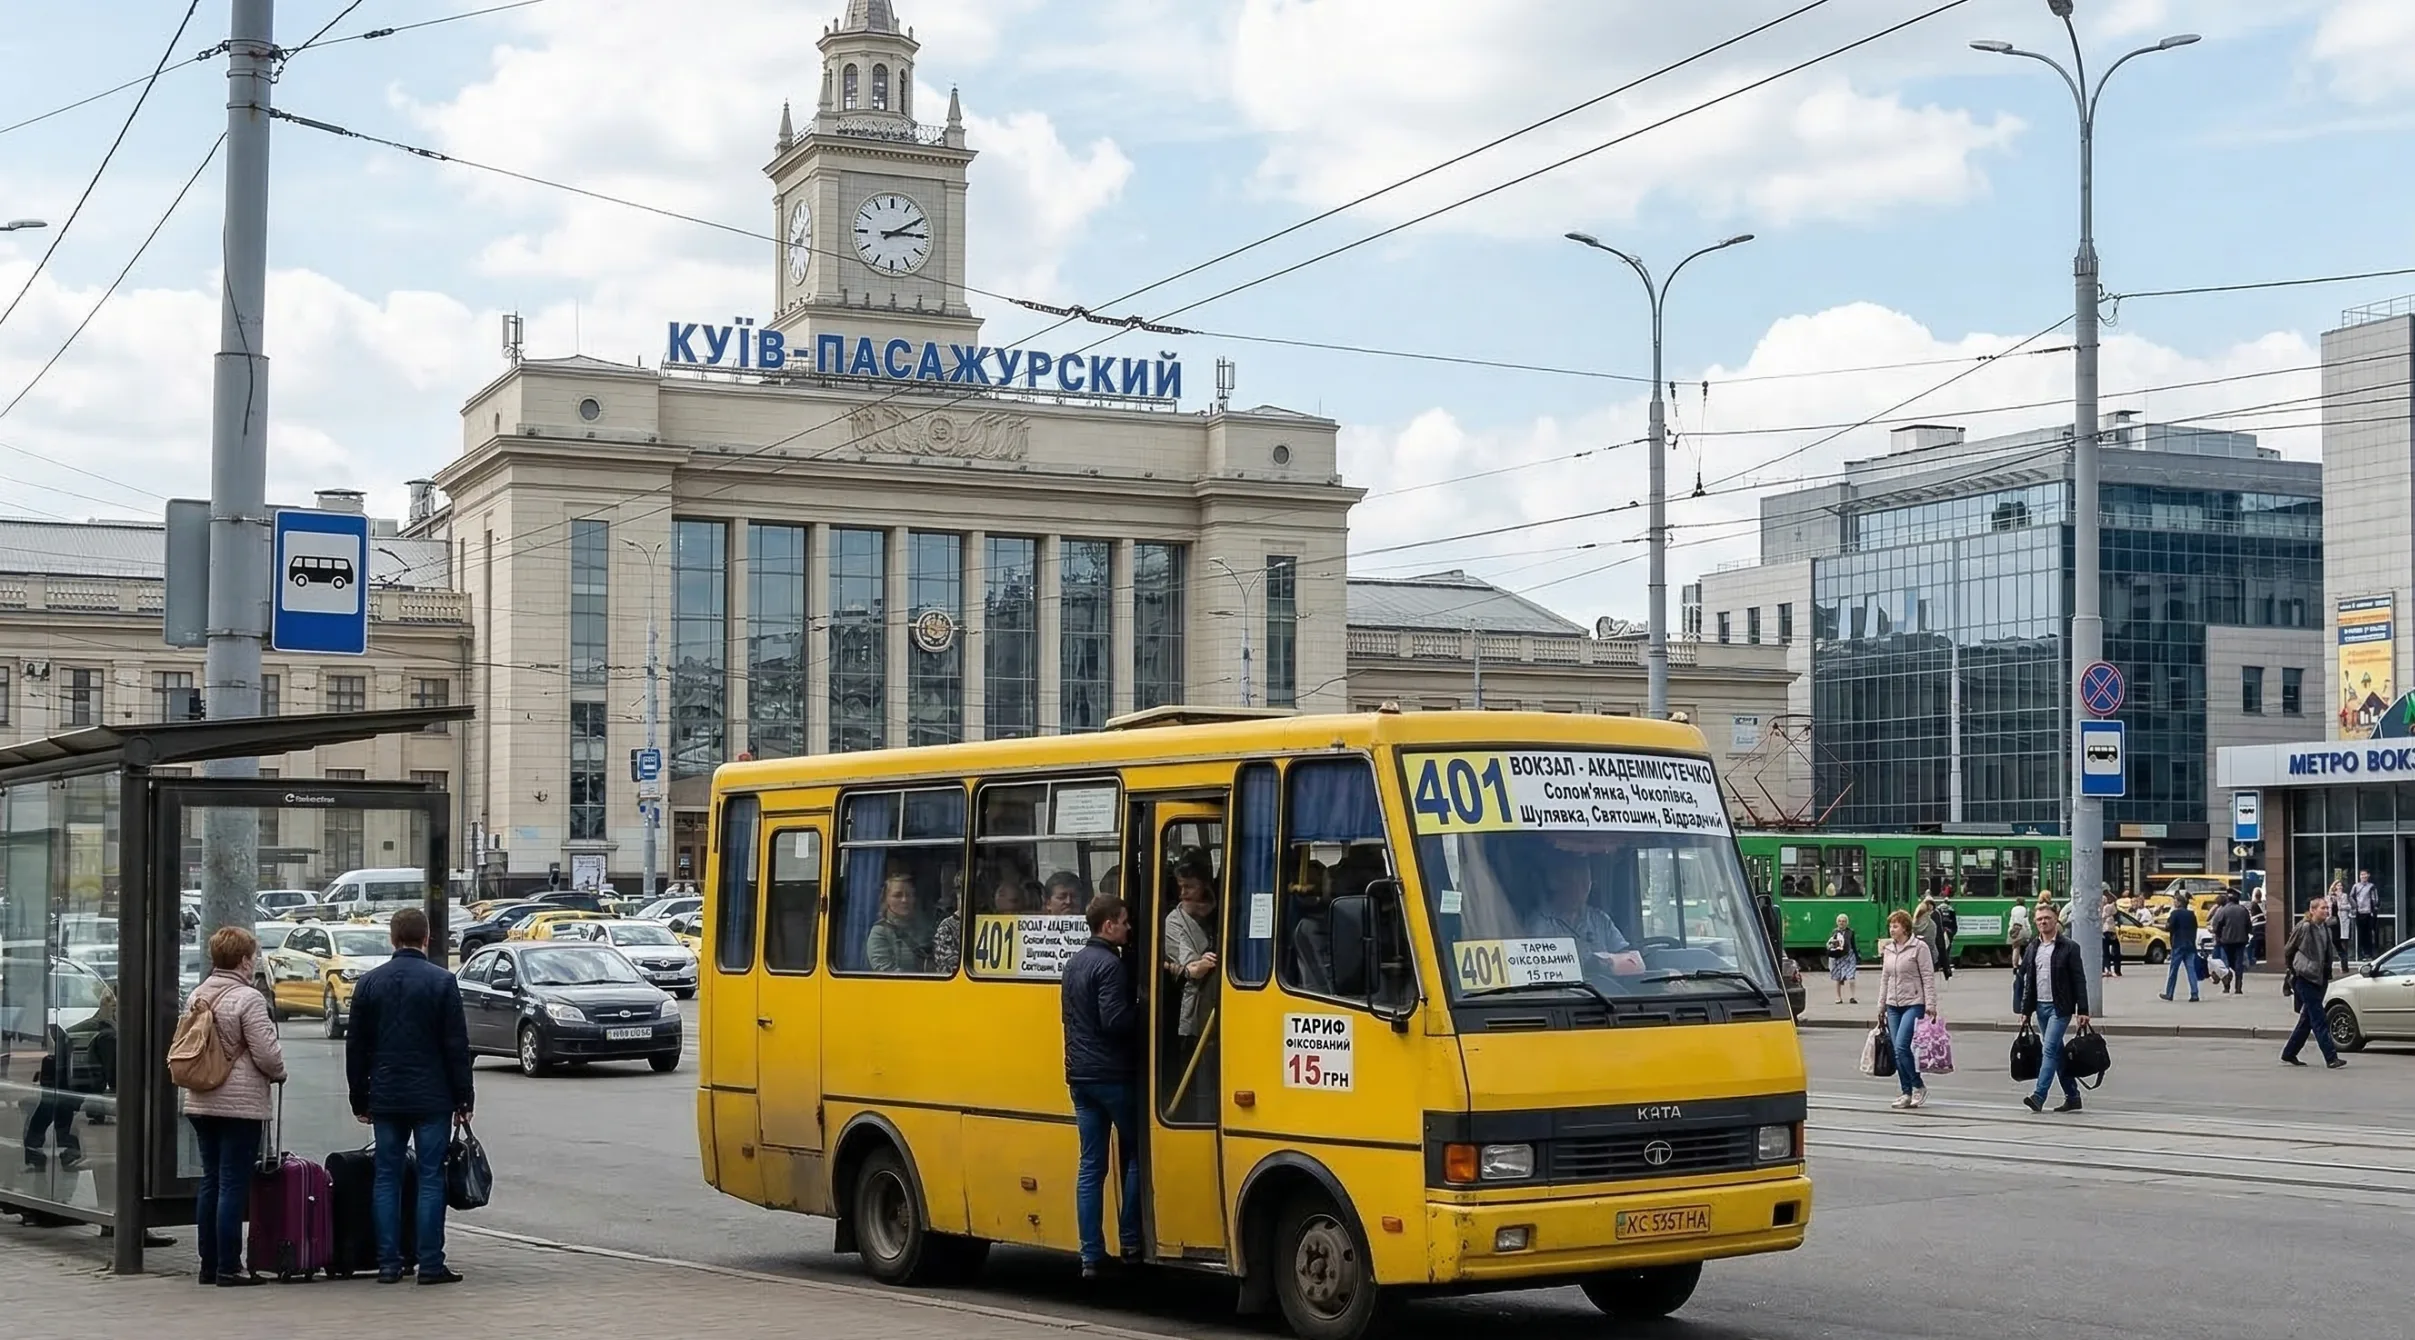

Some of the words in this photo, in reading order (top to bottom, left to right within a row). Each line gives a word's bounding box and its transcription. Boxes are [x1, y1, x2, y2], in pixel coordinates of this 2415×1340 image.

[1509, 756, 1575, 776] ВОКЗАЛ
[1588, 757, 1712, 784] АКАДЕММІСТЕЧКО
[2289, 751, 2359, 774] МЕТРО
[1415, 758, 1513, 824] 401
[1544, 782, 1630, 805] Солом'янка,
[1630, 784, 1698, 808] Чоколівка,
[1520, 805, 1590, 827] Шулявка,
[1592, 805, 1662, 828] Святошин,
[975, 920, 1014, 969] 401
[1461, 946, 1505, 985] 401
[1527, 970, 1541, 980] 15
[1292, 1018, 1345, 1035] ТАРИФ
[1289, 1054, 1321, 1085] 15
[1323, 1072, 1349, 1087] ГРН
